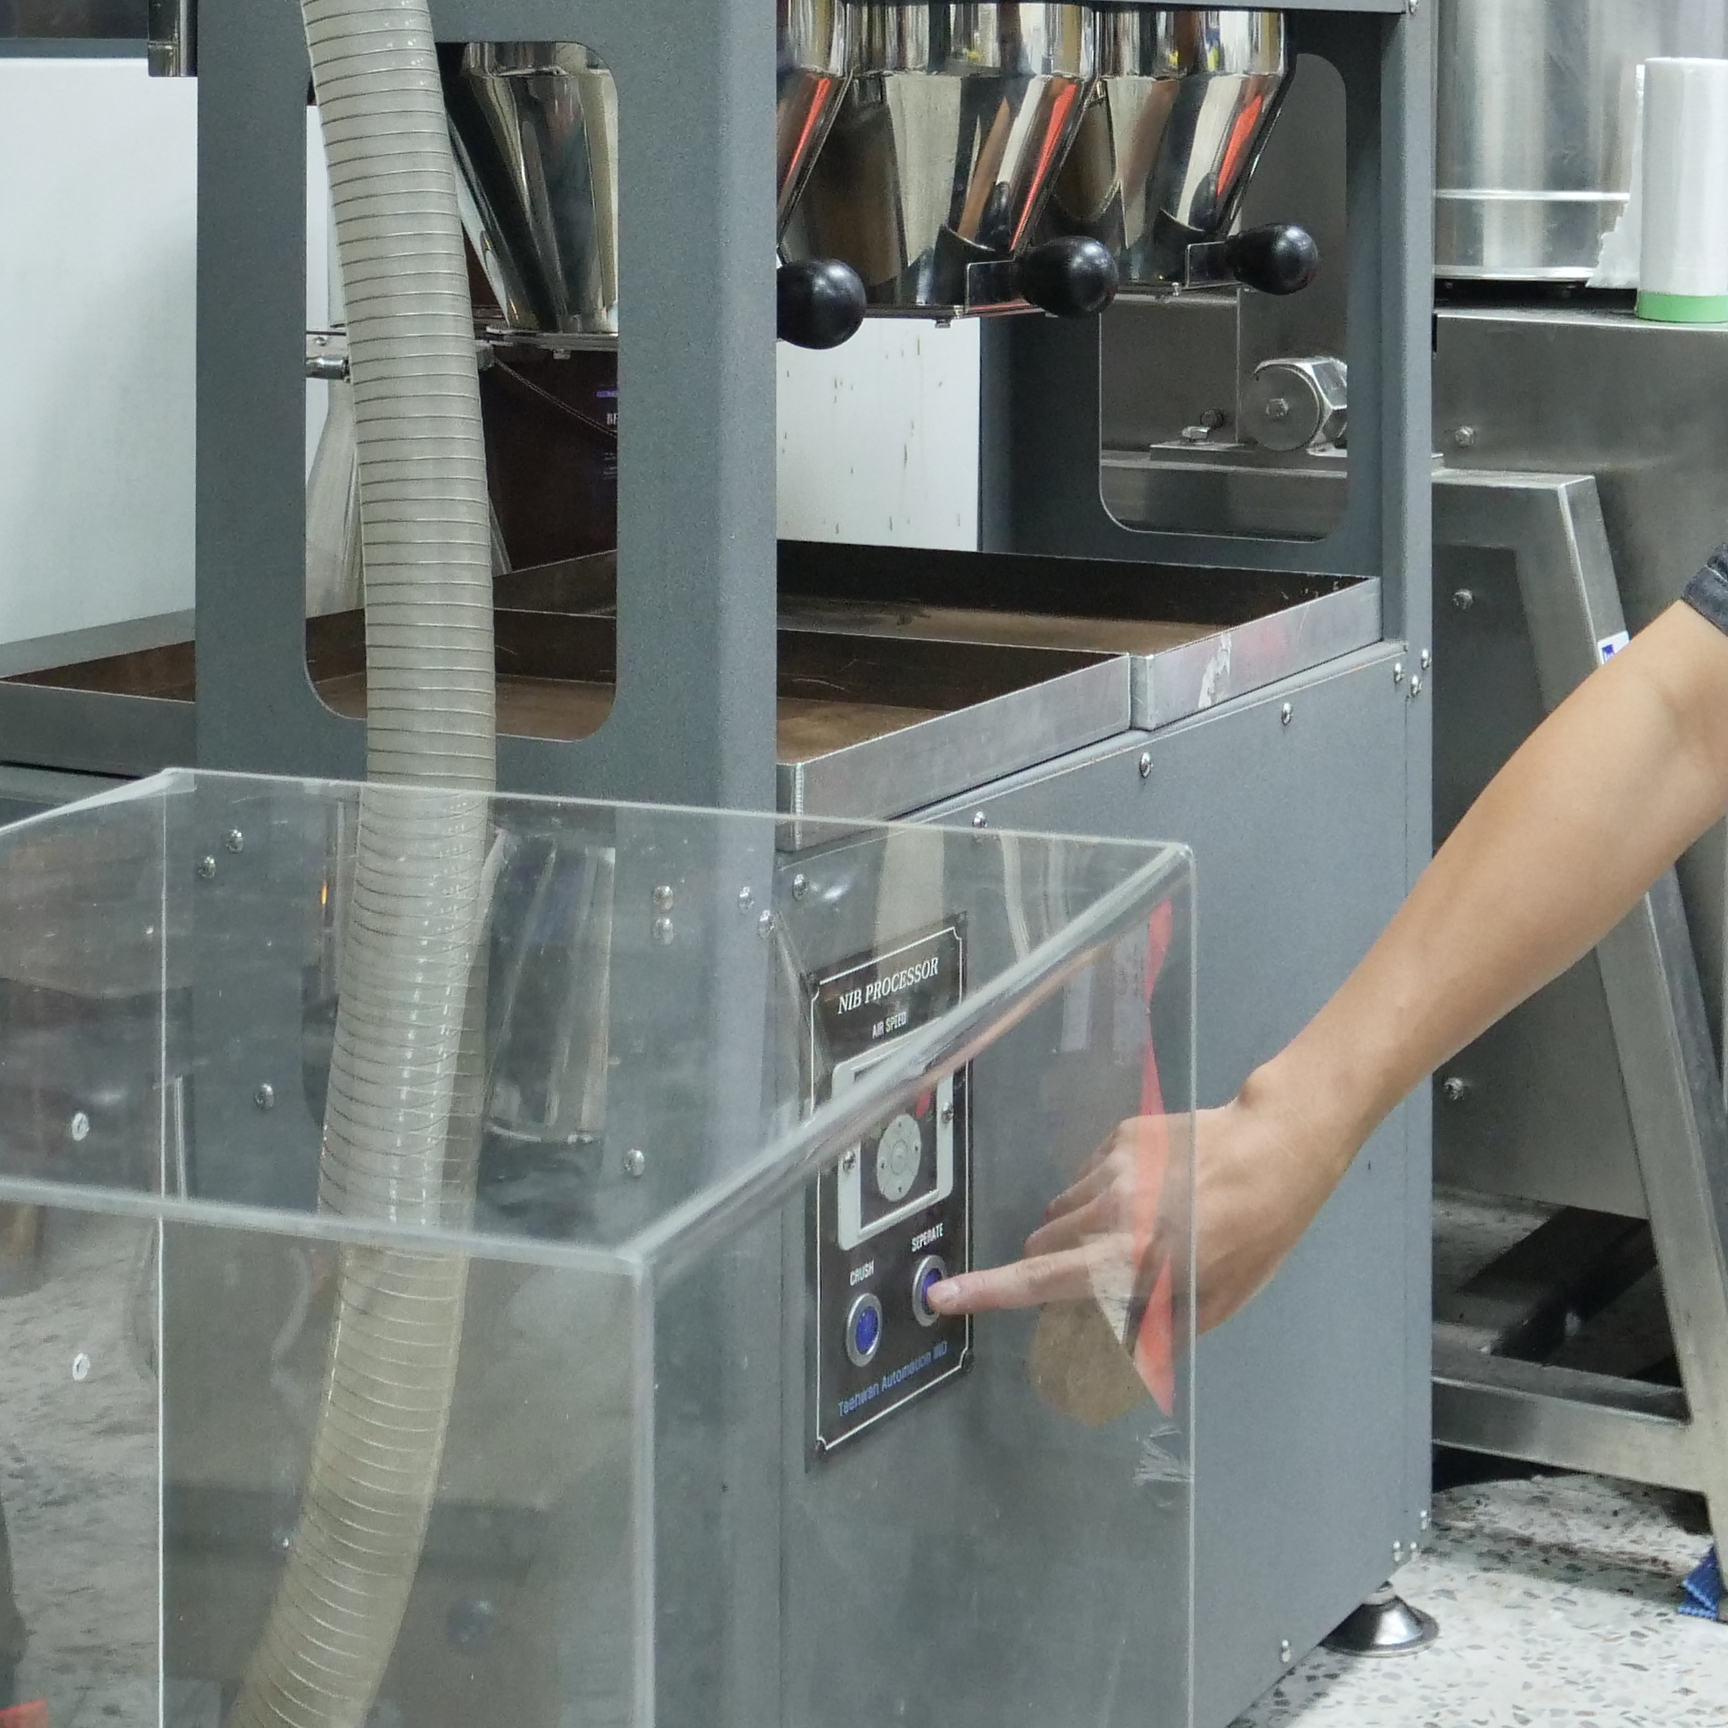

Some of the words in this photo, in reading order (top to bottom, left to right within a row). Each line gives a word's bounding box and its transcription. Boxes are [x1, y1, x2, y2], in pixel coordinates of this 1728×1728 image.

[838, 989, 862, 1015] NIB
[864, 956, 939, 1004] PROCESSOR
[872, 1021, 885, 1039] AIR
[885, 1011, 907, 1033] SPEED
[911, 1222, 945, 1253] SEPERATE
[849, 1258, 875, 1287] CRUSH
[881, 1350, 932, 1392] Automation
